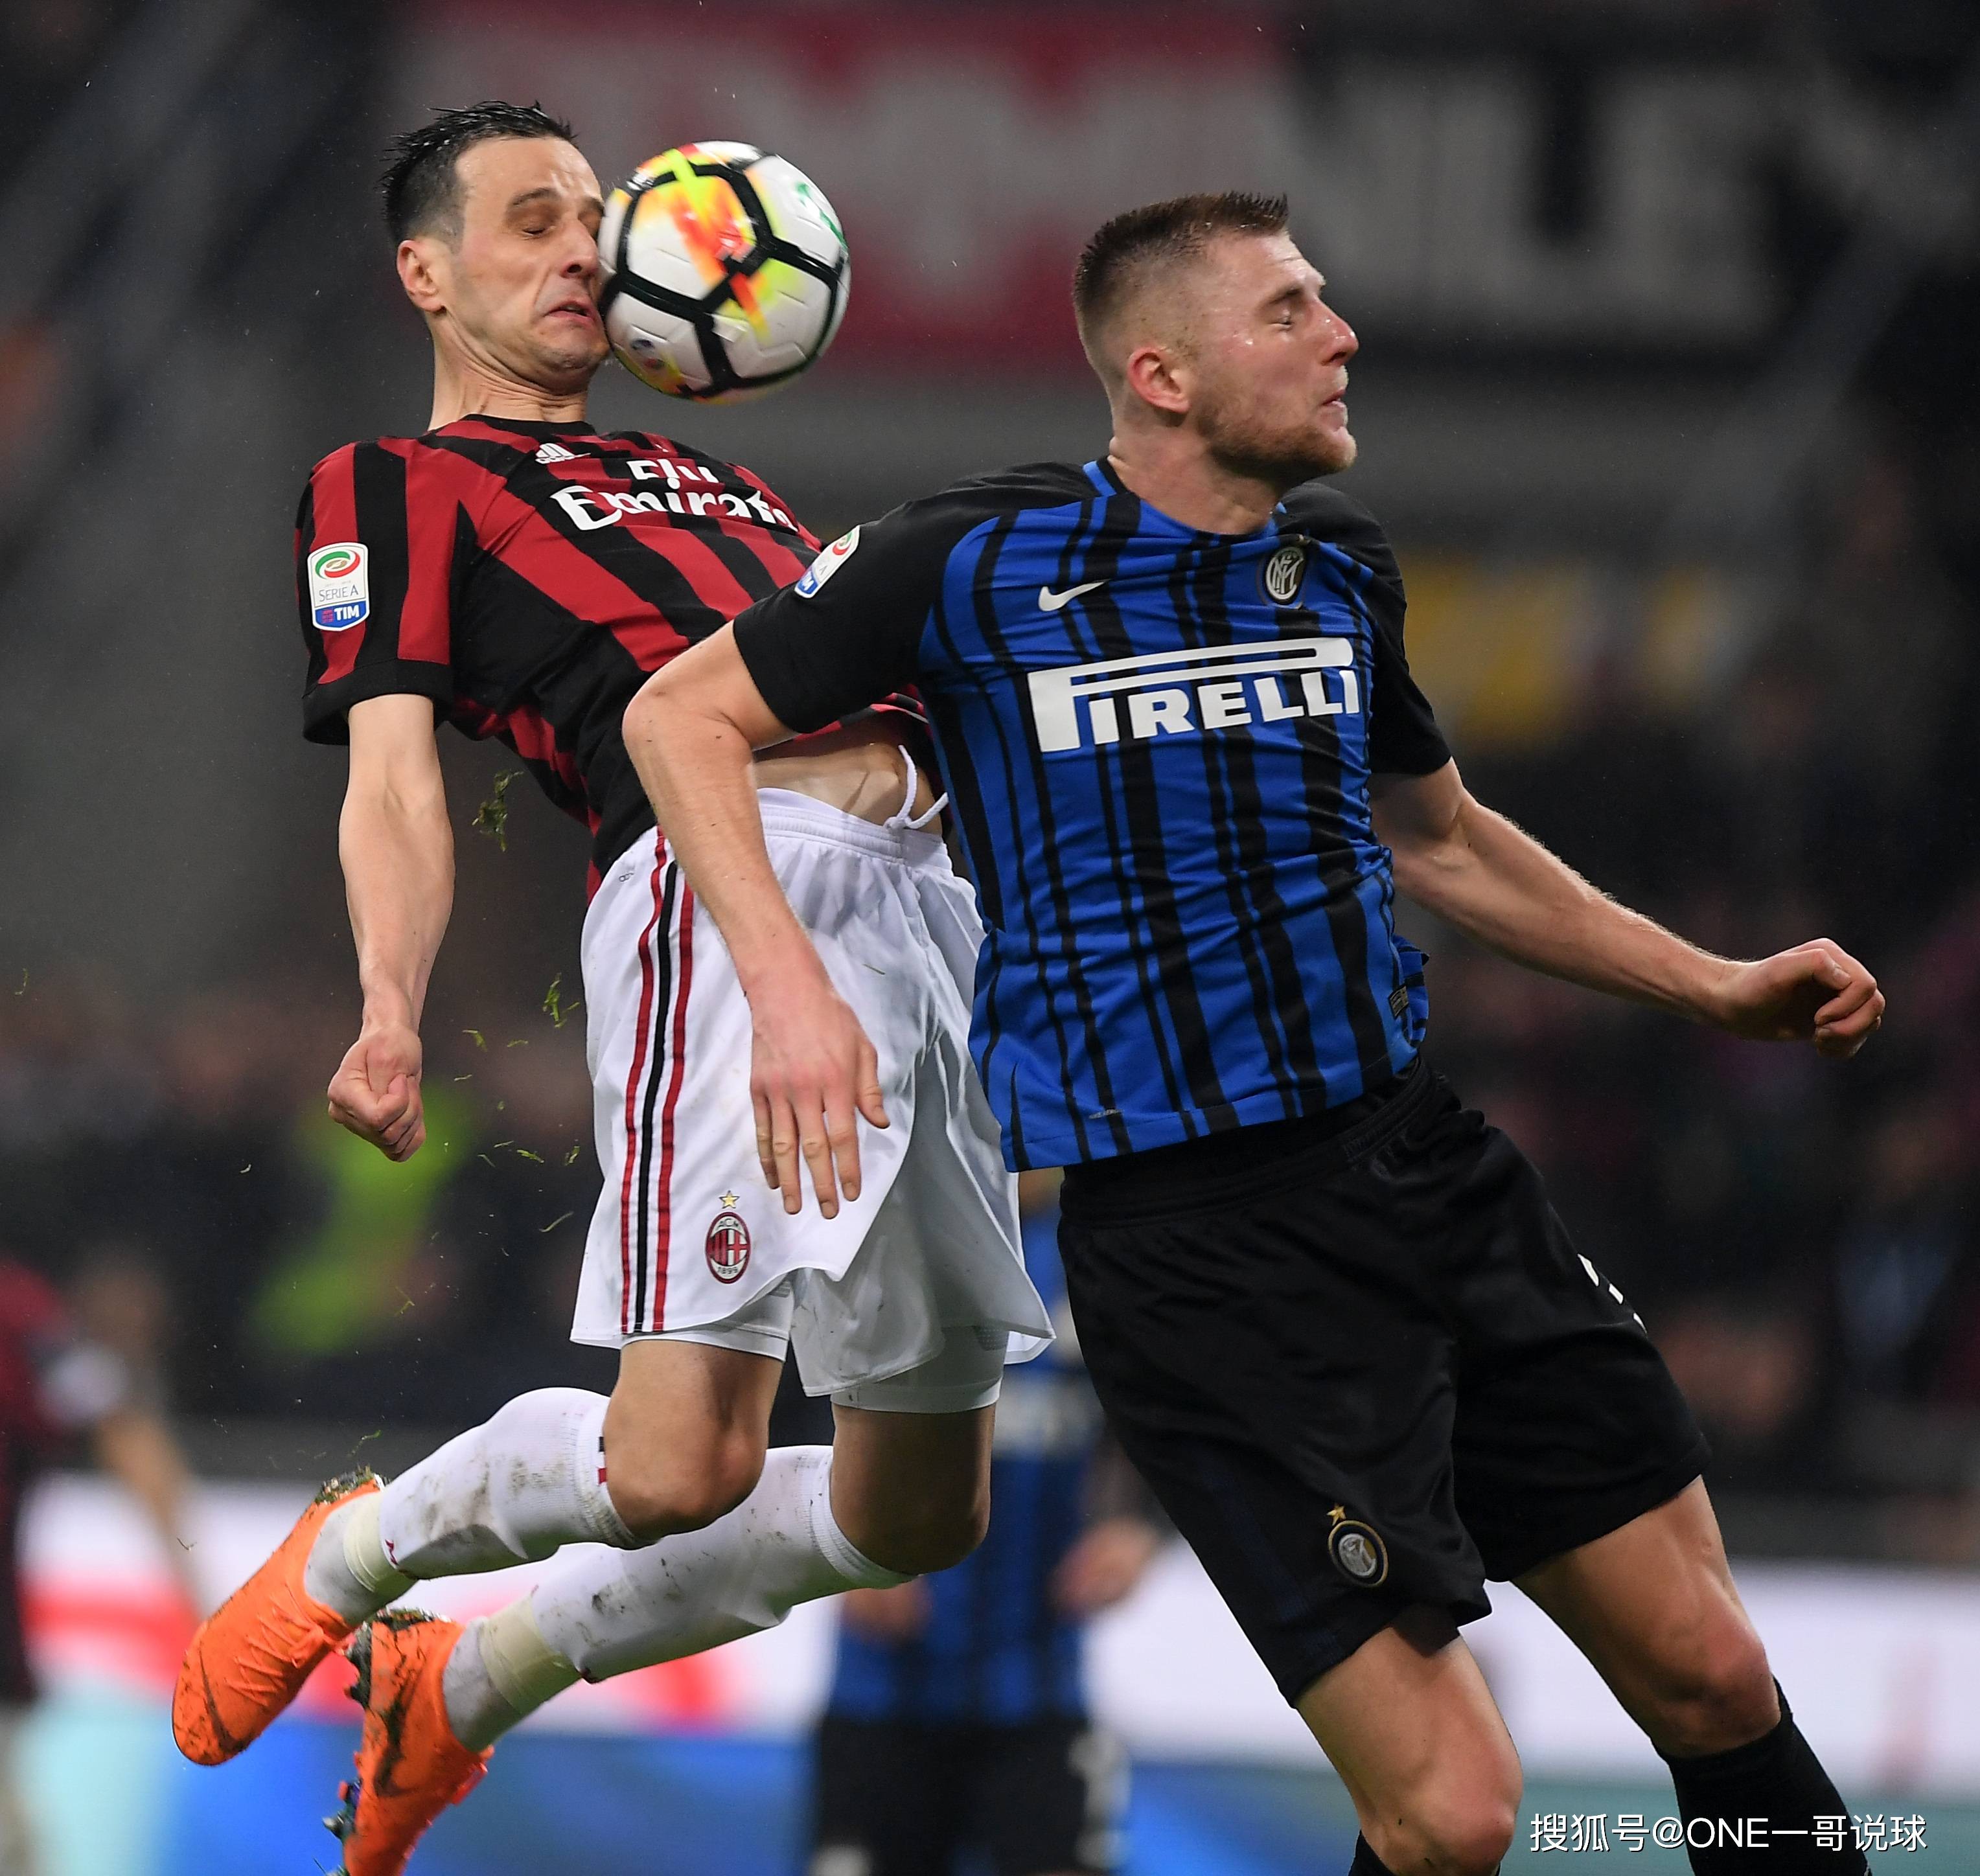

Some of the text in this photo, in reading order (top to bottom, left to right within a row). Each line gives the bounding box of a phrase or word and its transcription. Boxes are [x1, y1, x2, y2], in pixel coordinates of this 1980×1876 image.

[319, 586, 349, 602] SERIE
[350, 584, 359, 596] A
[334, 604, 360, 621] TIM
[1028, 637, 1360, 753] PIRELLI
